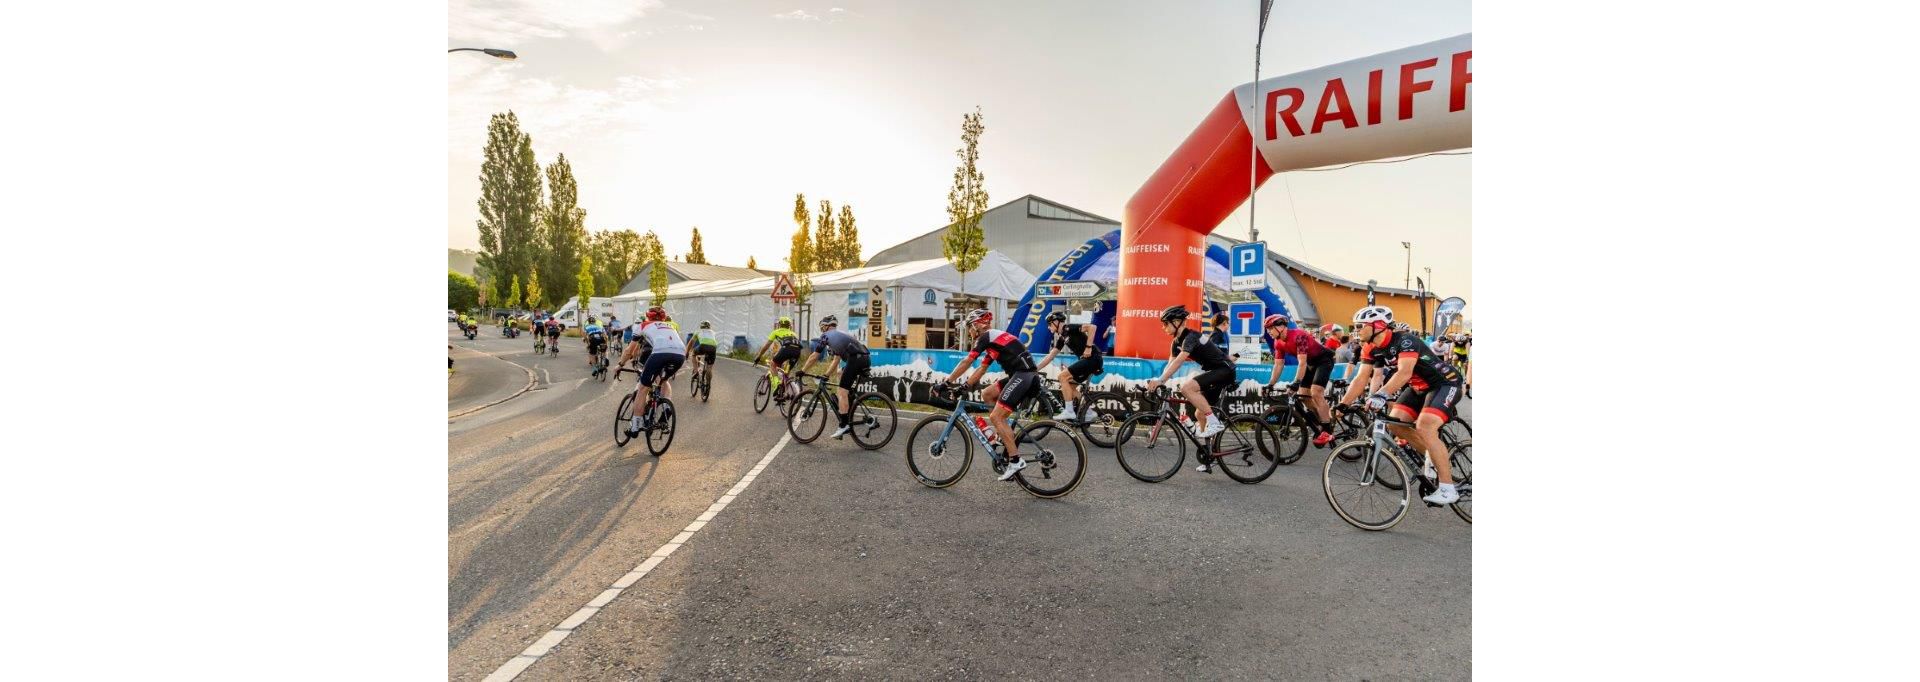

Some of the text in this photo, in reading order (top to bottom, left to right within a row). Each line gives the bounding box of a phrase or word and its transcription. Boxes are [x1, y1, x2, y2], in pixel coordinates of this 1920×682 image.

[1126, 244, 1170, 254] RAIFFEISEN
[1241, 249, 1256, 272] P
[1124, 277, 1168, 286] RAIFFEISEN
[868, 300, 882, 337] cellere
[1228, 401, 1271, 414] säntis
[961, 411, 993, 453] FOCUS
